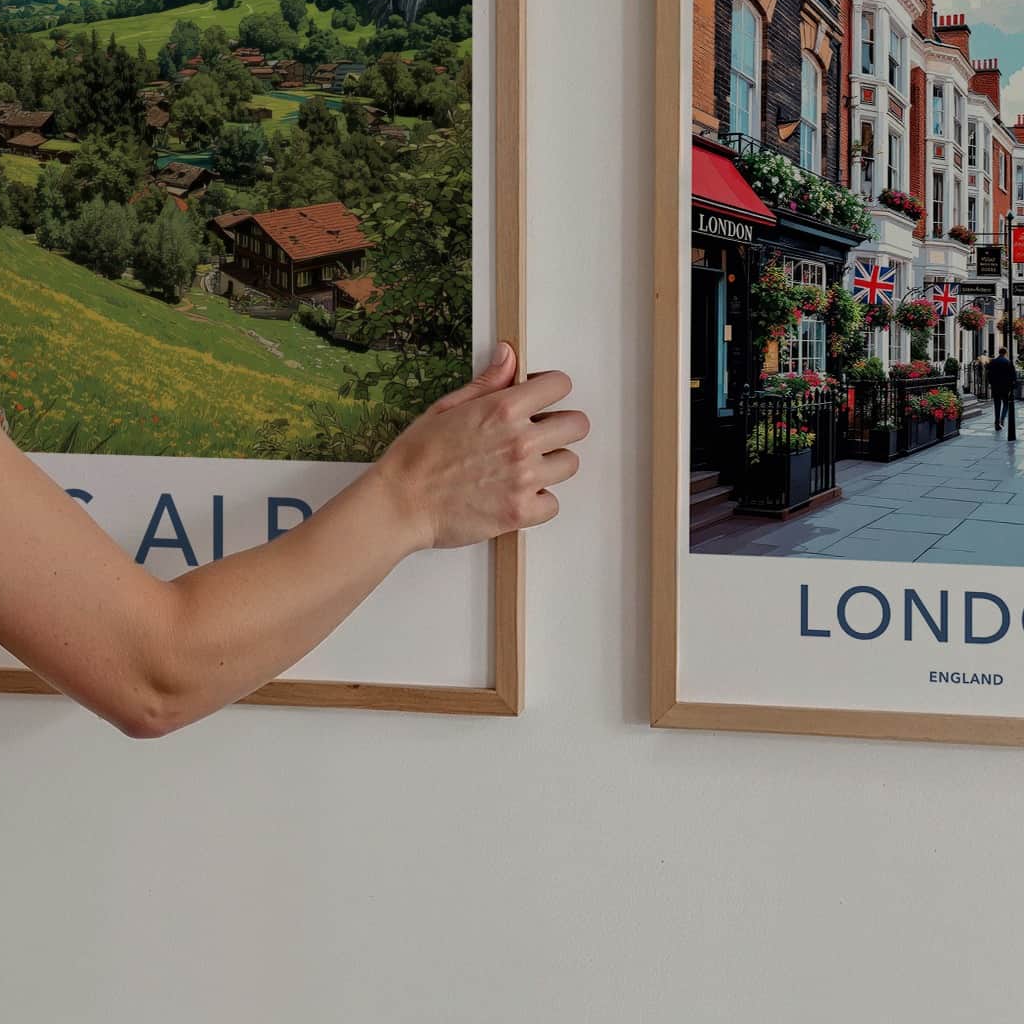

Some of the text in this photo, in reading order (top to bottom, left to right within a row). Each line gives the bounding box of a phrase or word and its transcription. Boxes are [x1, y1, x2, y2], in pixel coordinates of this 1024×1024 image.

[699, 213, 753, 242] LONDON
[800, 584, 1024, 644] LOND
[929, 671, 1004, 686] ENGLAND
